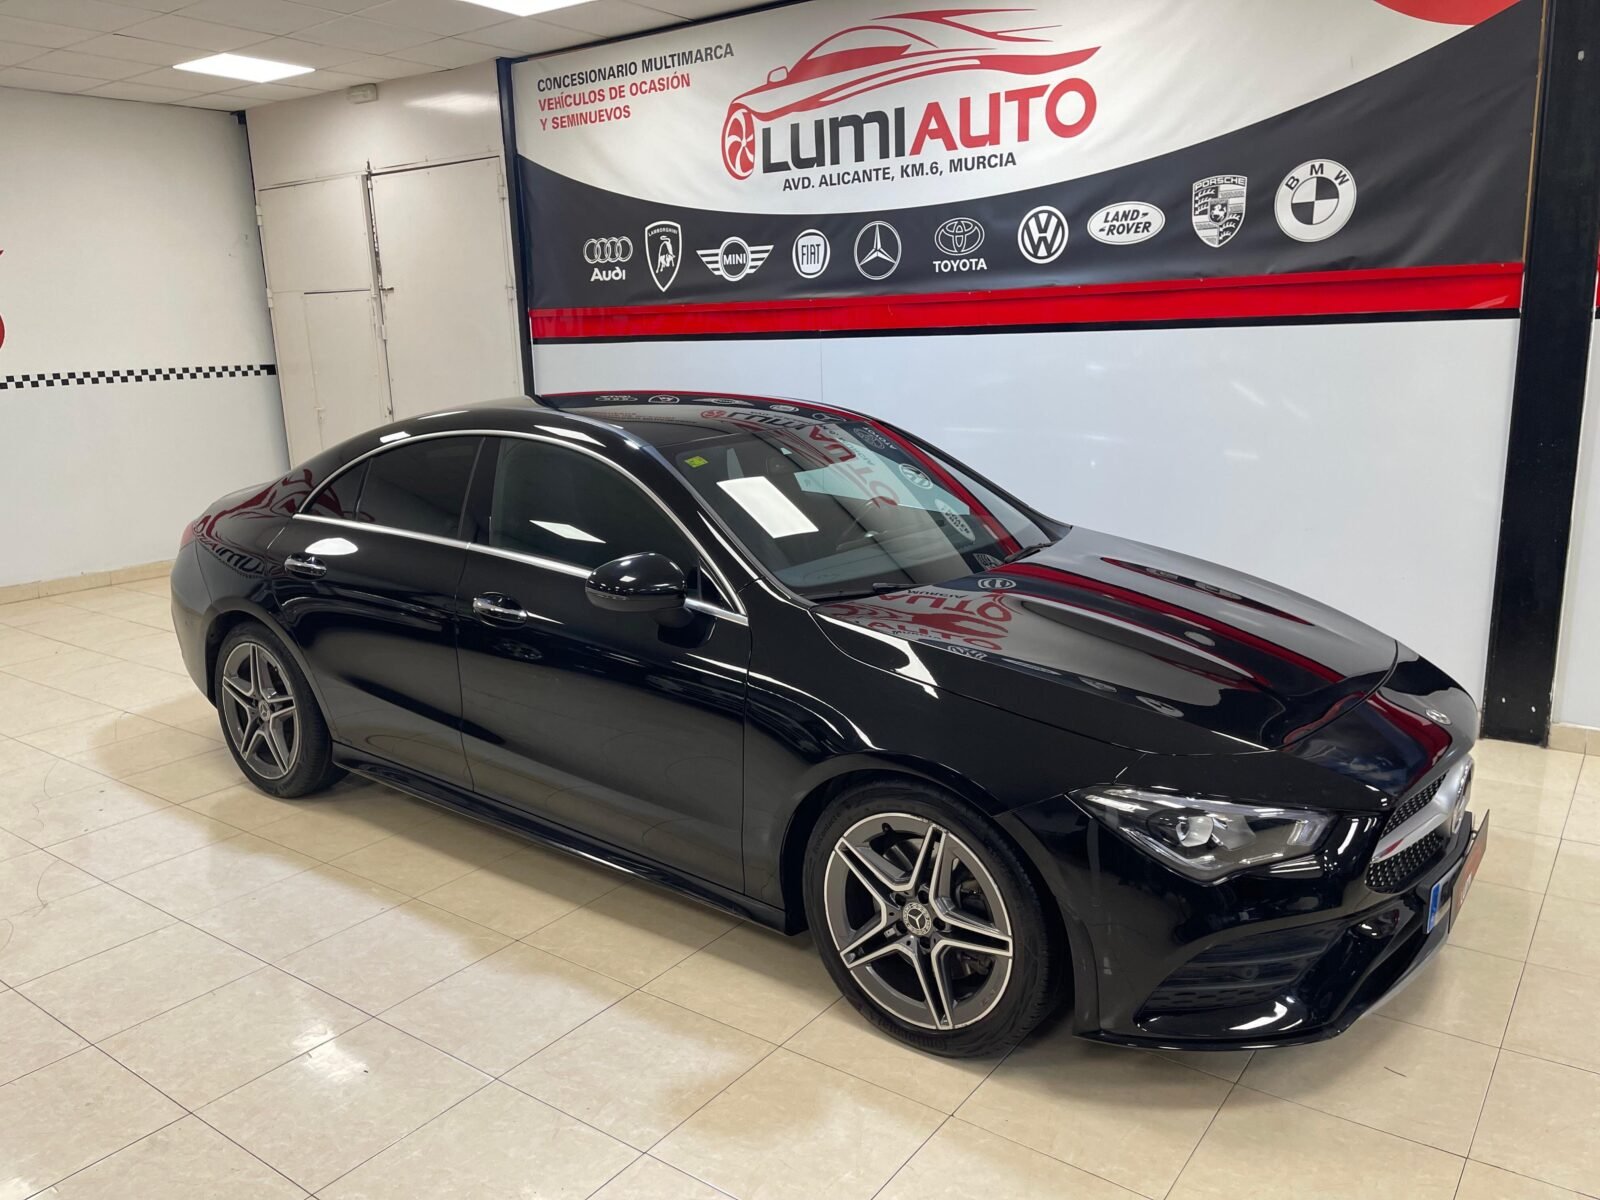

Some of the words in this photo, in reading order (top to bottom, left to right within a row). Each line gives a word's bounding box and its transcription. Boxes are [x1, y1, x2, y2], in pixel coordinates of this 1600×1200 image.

[537, 61, 637, 92] CONCESIONARIO
[641, 43, 734, 73] MULTIMARCA
[538, 88, 605, 112] VEHÍCULOS
[609, 85, 625, 100] DE
[629, 71, 691, 96] OCASIÓN
[539, 117, 548, 131] Y
[551, 105, 631, 129] SEMINUEVOS
[782, 177, 815, 192] AVD.
[818, 167, 895, 188] ALICANTE,
[900, 161, 944, 180] KM.6,
[949, 152, 1016, 174] MURCIA
[1194, 176, 1246, 191] PORSCHE
[1285, 162, 1350, 191] BMW
[723, 253, 747, 266] MINI
[801, 243, 822, 266] FIAT
[933, 258, 988, 273] TOYOTA
[590, 267, 626, 282] Audi
